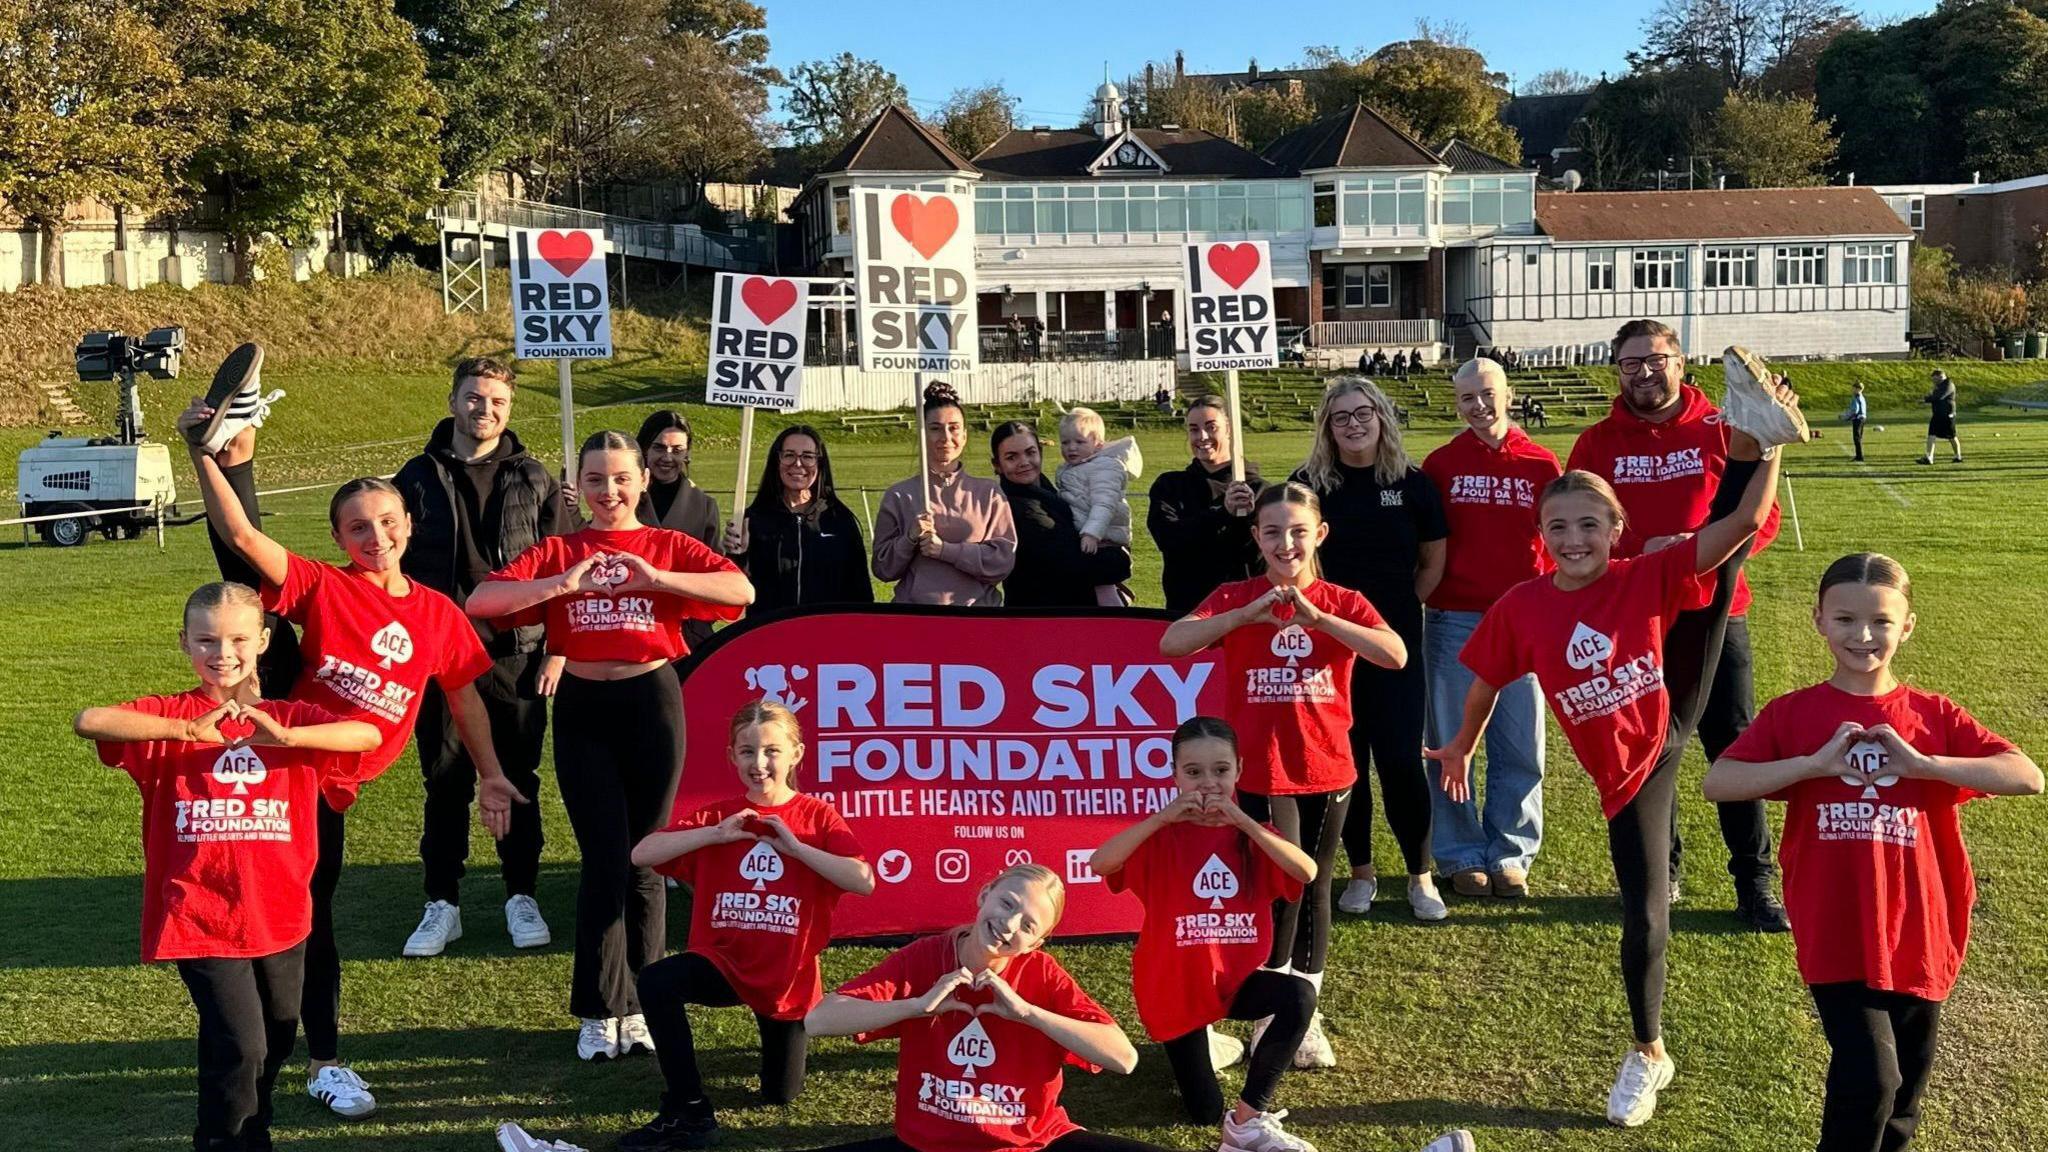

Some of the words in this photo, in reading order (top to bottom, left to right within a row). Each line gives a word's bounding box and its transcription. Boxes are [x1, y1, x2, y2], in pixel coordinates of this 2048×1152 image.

[864, 193, 882, 260] I
[516, 231, 531, 279] I
[1188, 246, 1202, 293] I
[519, 283, 602, 310] RED
[867, 265, 967, 306] RED
[719, 275, 733, 323] I
[1191, 294, 1268, 324] RED
[523, 315, 603, 343] SKY
[872, 310, 968, 350] SKY
[716, 326, 798, 360] RED
[1195, 326, 1269, 355] SKY
[524, 347, 606, 358] FOUNDATION
[872, 357, 971, 371] FOUNDATION
[1196, 359, 1273, 371] FOUNDATION
[714, 359, 796, 392] SKY
[712, 393, 795, 408] FOUNDATION
[1626, 456, 1662, 467] RED
[1666, 447, 1701, 464] SKY
[1463, 475, 1499, 488] RED
[1502, 477, 1535, 493] SKY
[1462, 489, 1534, 503] FOUDAION
[575, 599, 613, 614] RED
[618, 597, 654, 614] SKY
[576, 612, 655, 625] FOUNDATION
[377, 631, 408, 656] ACE
[1277, 634, 1306, 650] ACE
[1572, 634, 1605, 662] ACE
[337, 659, 382, 690] RED
[381, 680, 416, 705] SKY
[1257, 668, 1297, 683] RED
[1566, 676, 1610, 701] RED
[1613, 650, 1655, 684] SKY
[817, 663, 1006, 728] RED
[1032, 662, 1215, 729] SKY
[1257, 685, 1334, 696] FOUNDATION
[221, 756, 257, 775] ACE
[818, 737, 1173, 783] FOUNDATIO
[192, 799, 246, 818] RED
[252, 799, 289, 818] SKY
[842, 789, 914, 818] LITTLE
[920, 789, 1005, 816] HEARTS
[1011, 790, 1057, 816] AND
[1062, 788, 1127, 816] THEIR
[1132, 787, 1178, 814] FAM
[191, 819, 290, 832] FOUNDATION
[1830, 803, 1874, 819] RED
[1878, 805, 1919, 826] SKY
[954, 825, 993, 838] FOLLOW
[995, 826, 1009, 838] US
[1010, 826, 1025, 838] ON
[1831, 820, 1918, 839] FOUNDATION
[746, 855, 777, 873] ACE
[1200, 872, 1231, 890] ACE
[721, 892, 760, 909] RED
[765, 894, 802, 914] SKY
[1186, 913, 1221, 928] RED
[1224, 913, 1256, 927] SKY
[1187, 927, 1257, 938] FOUNDATION
[954, 1036, 989, 1059] ACE
[935, 1077, 975, 1099] RED
[979, 1083, 1026, 1102] SKY
[935, 1096, 1026, 1116] FOUNDATION
